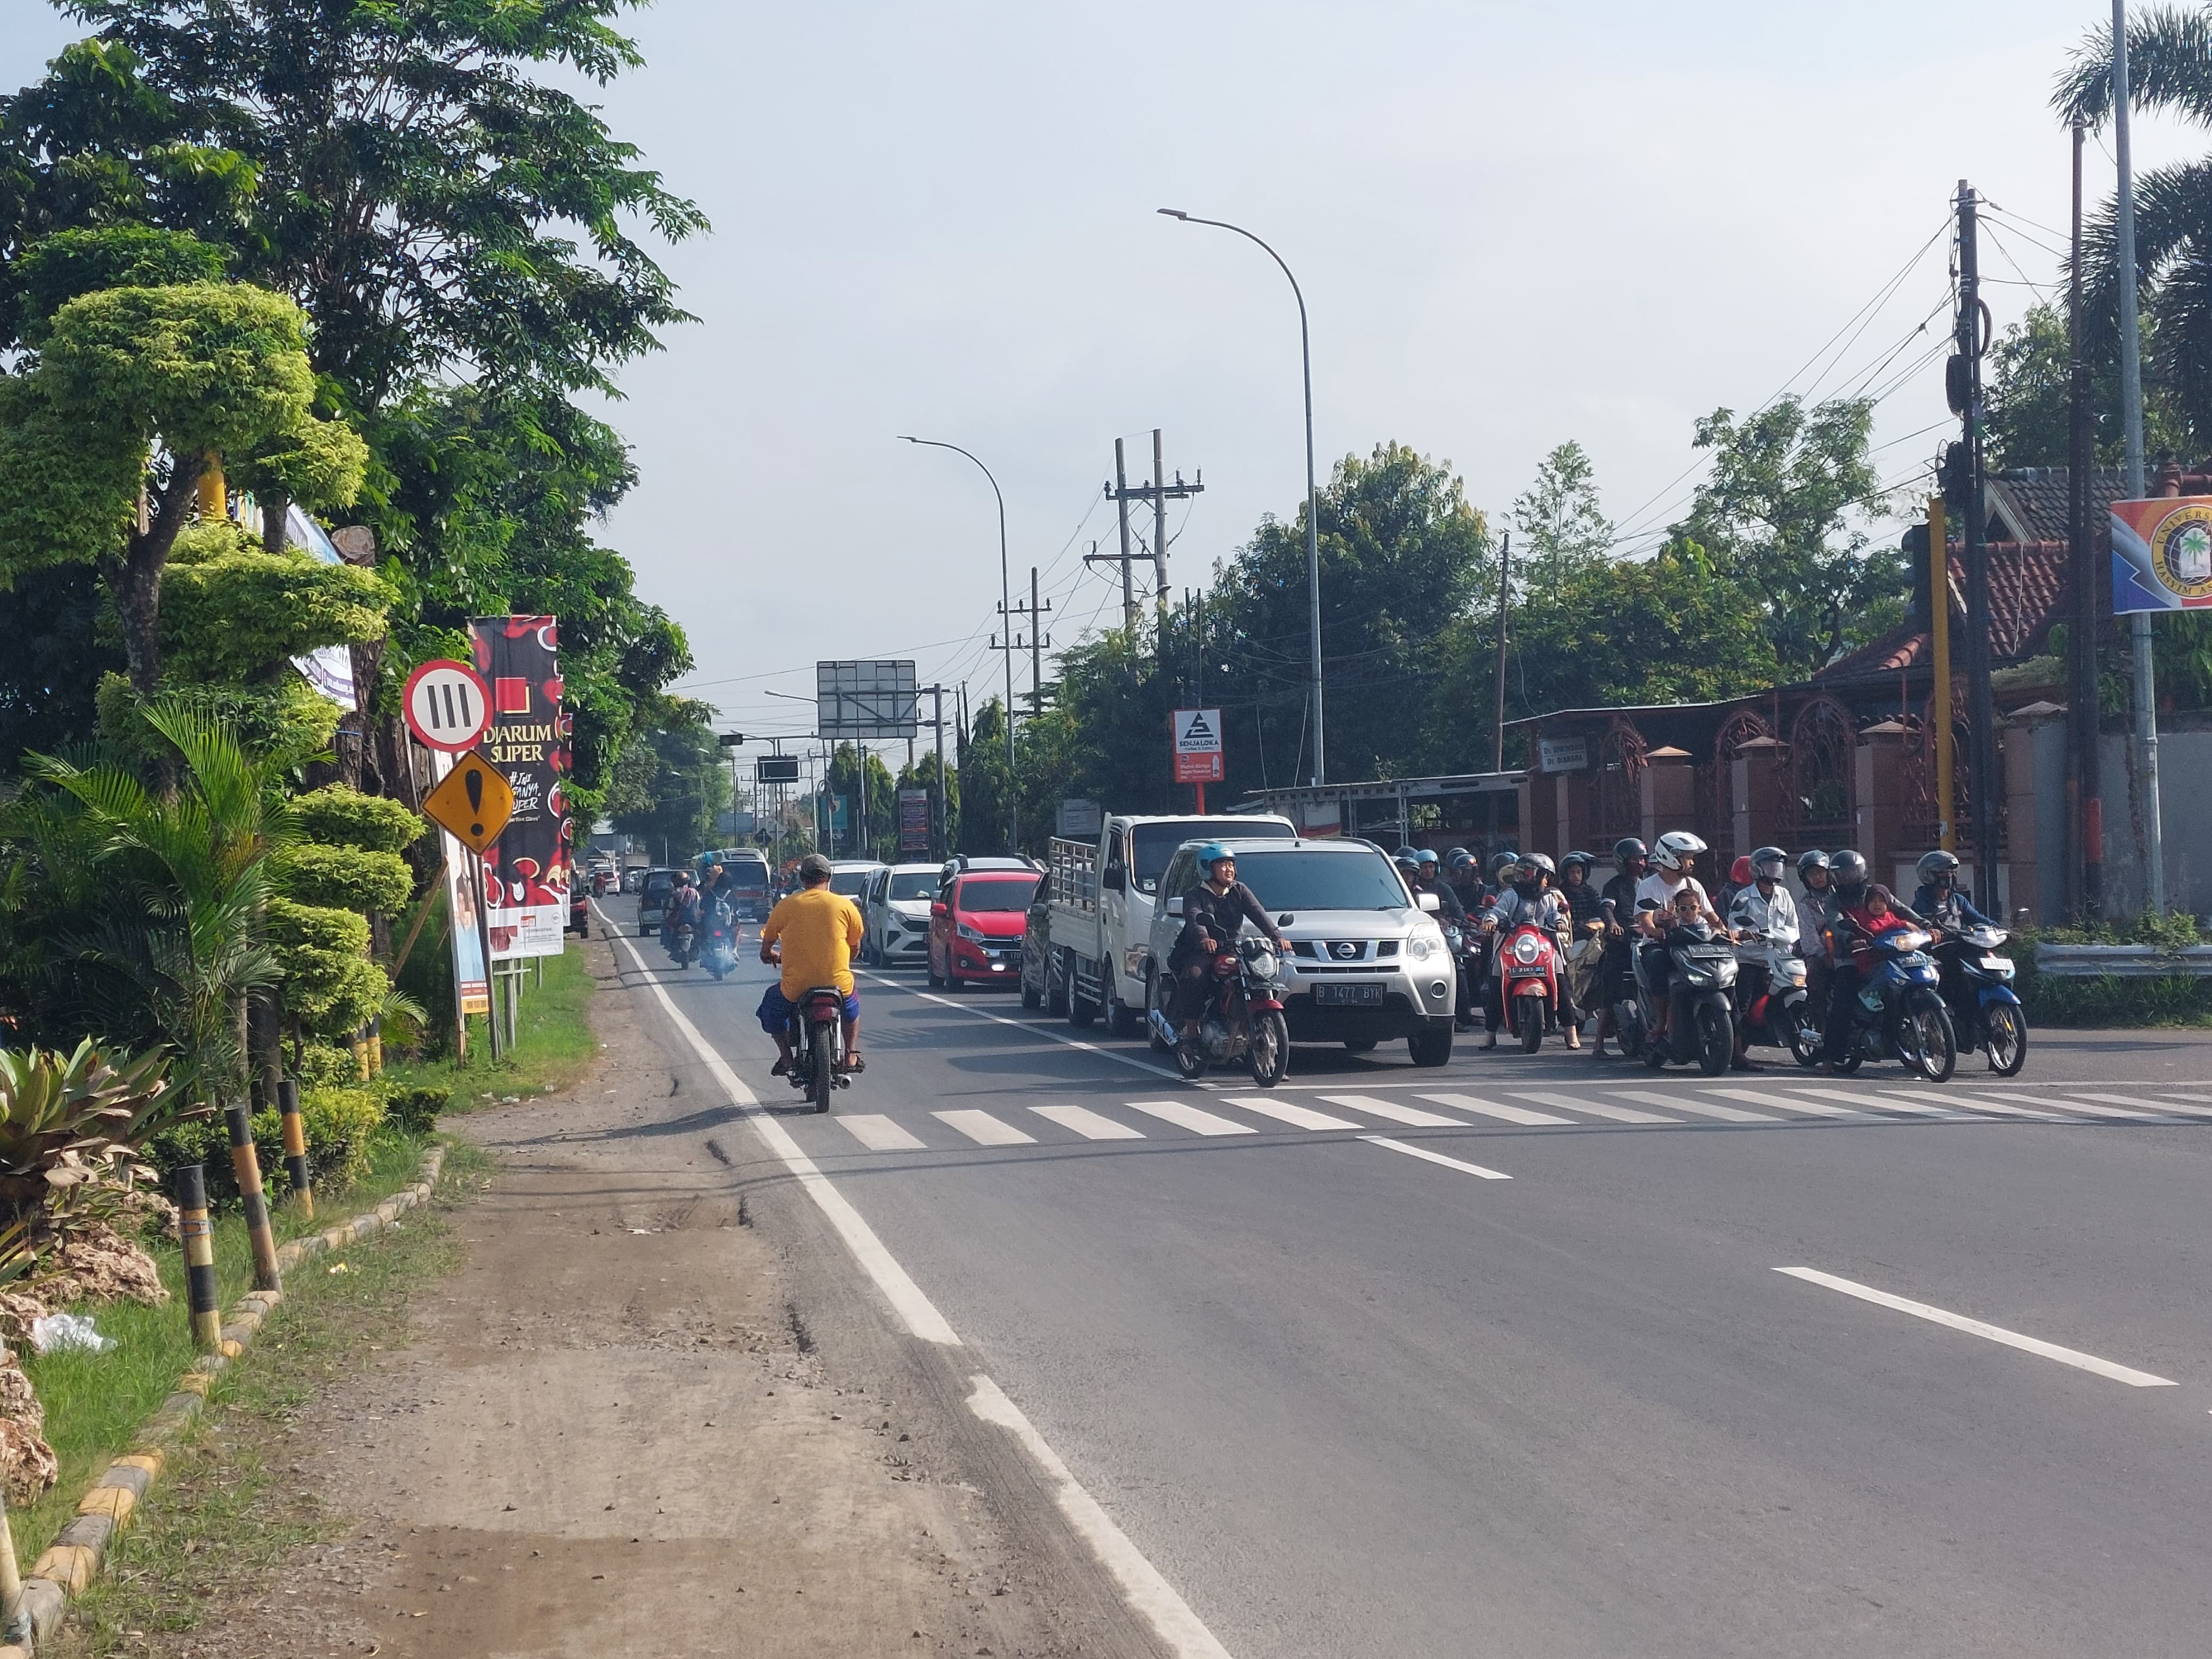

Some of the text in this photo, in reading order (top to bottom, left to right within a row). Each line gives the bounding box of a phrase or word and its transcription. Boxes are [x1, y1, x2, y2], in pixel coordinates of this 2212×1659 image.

[2156, 561, 2191, 594] HASYIM
[483, 724, 552, 744] DJARUM
[491, 744, 544, 763] SUPER
[513, 797, 539, 810] UPER
[1319, 986, 1381, 999] B 1477 BYK
